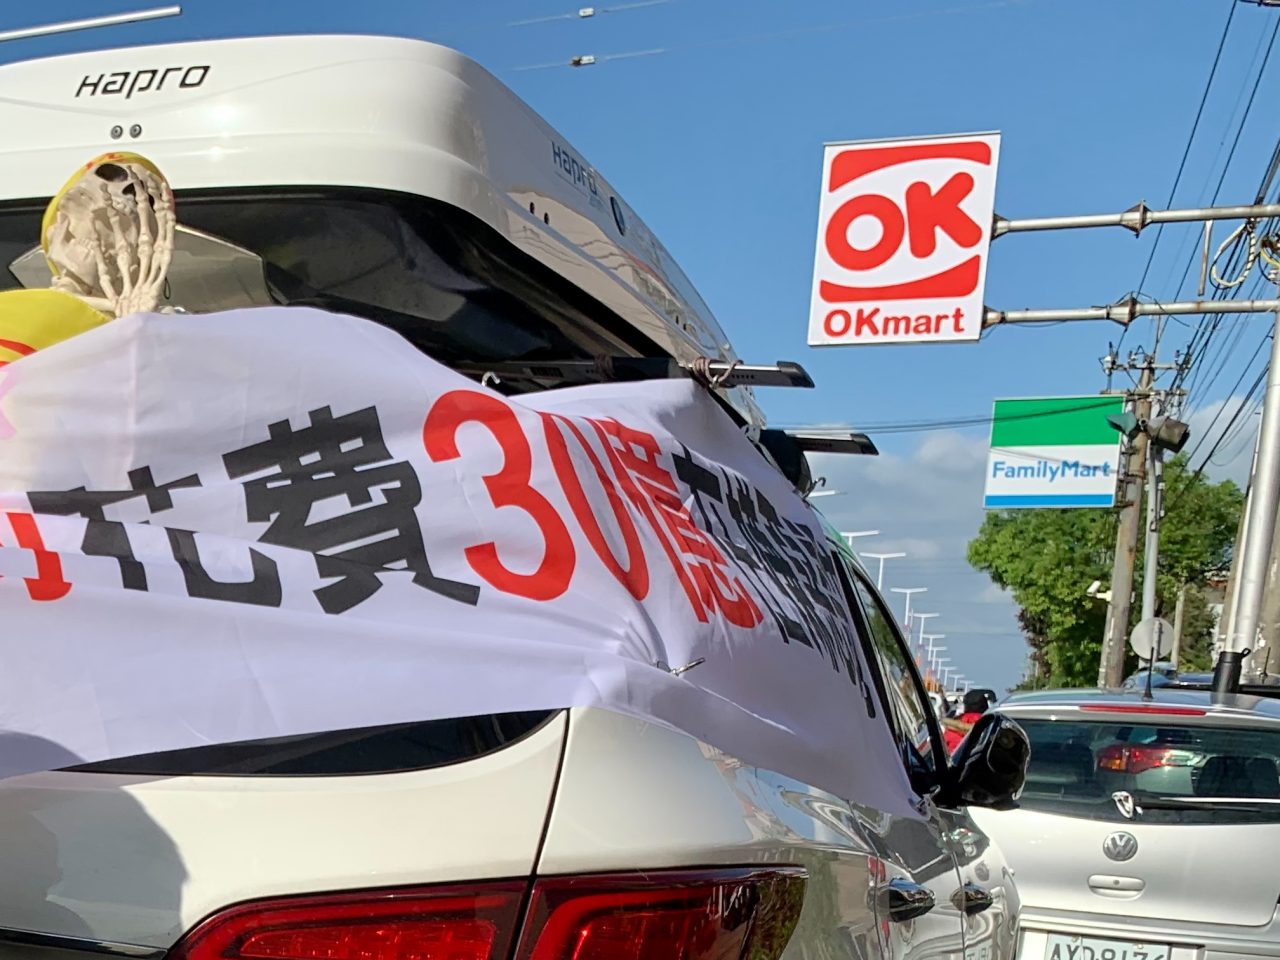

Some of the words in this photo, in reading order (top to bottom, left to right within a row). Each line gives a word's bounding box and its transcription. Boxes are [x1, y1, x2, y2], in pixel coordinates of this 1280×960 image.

[825, 172, 983, 271] OK
[823, 307, 965, 338] OKmart
[992, 459, 1111, 482] FamilyMart
